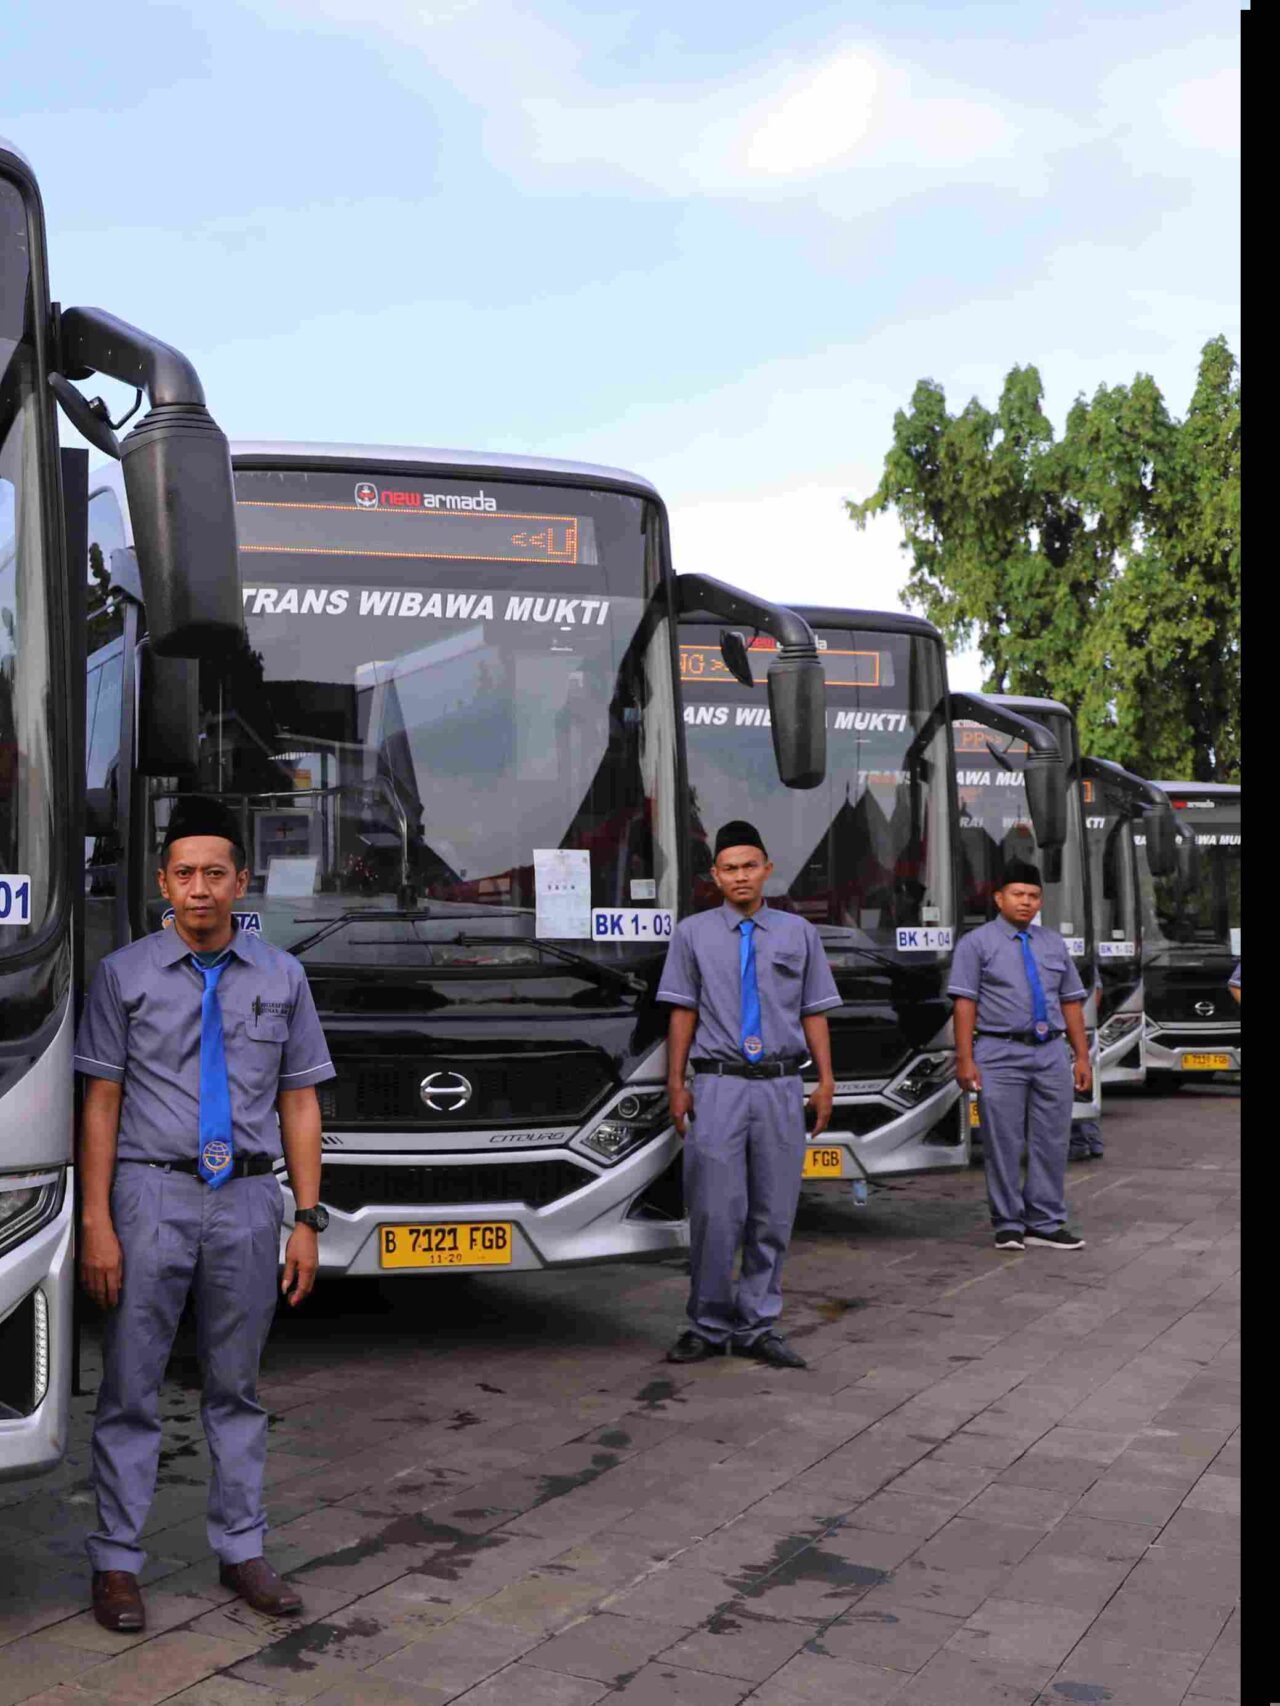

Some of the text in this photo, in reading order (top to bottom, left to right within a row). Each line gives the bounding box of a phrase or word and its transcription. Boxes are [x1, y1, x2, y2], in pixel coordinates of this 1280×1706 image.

[381, 489, 497, 512] new armada
[242, 587, 610, 626] TRANS WIBAWA MUKTI
[683, 706, 730, 726] ANS
[834, 711, 907, 732] MUKTI
[595, 913, 624, 936] BK
[899, 931, 918, 947] BK
[813, 1150, 839, 1167] FGB
[384, 1226, 507, 1254] B 7121 FGB
